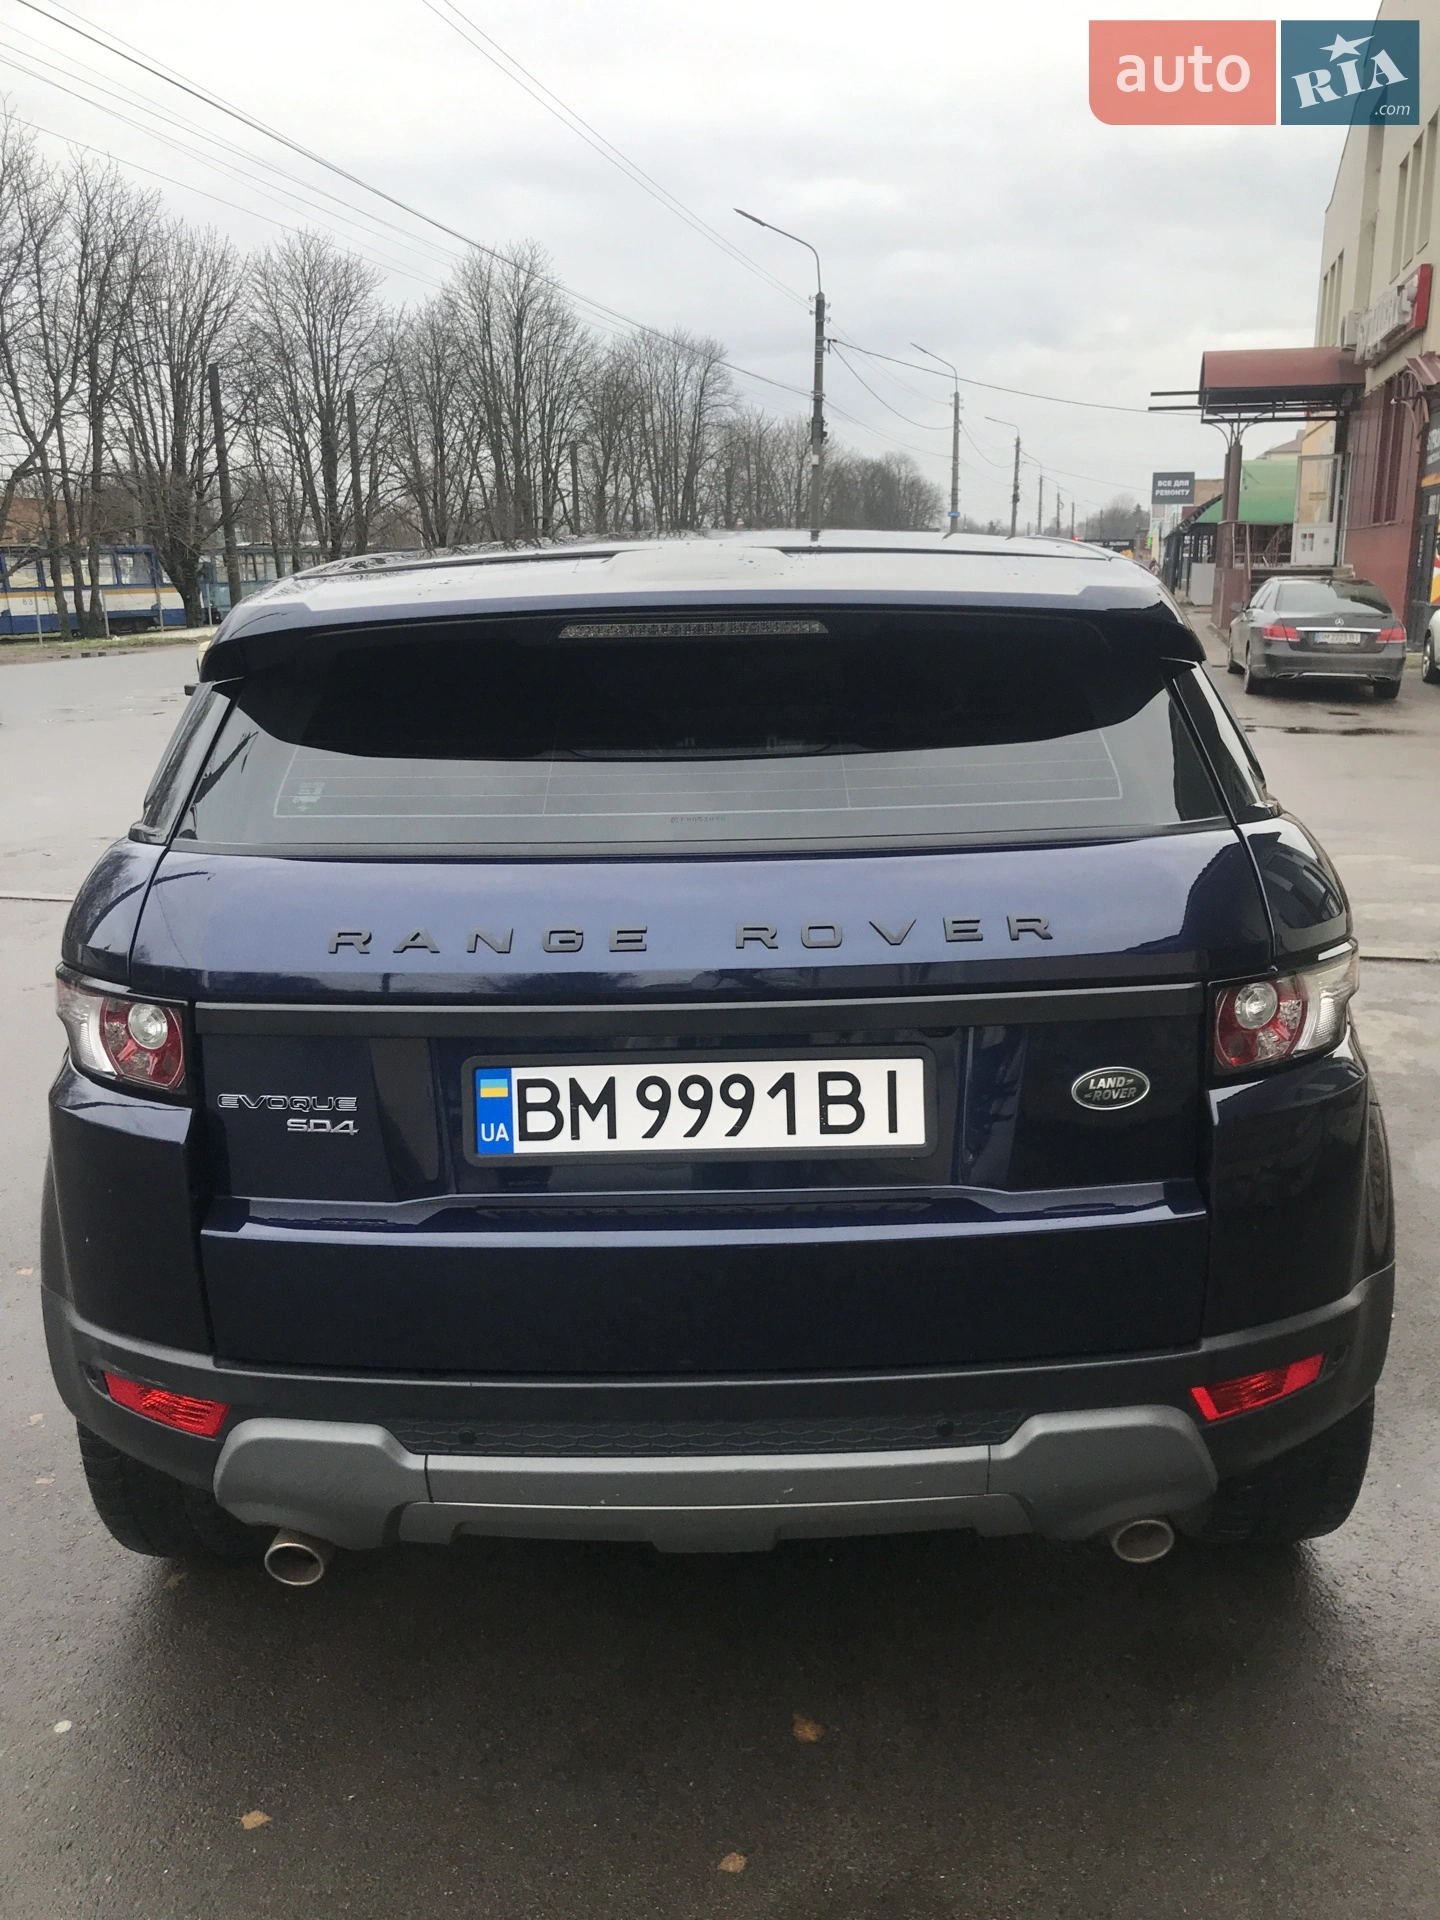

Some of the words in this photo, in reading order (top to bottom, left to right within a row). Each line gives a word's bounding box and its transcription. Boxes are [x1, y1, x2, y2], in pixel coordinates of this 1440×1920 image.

[1157, 479, 1173, 487] ВСЕ
[1173, 479, 1190, 488] ДЛЯ
[1154, 489, 1191, 497] РЕМОНТУ
[328, 927, 648, 954] RANGE
[735, 913, 1054, 951] ROVER
[1088, 1076, 1126, 1090] LAND
[217, 1093, 358, 1112] EVOQUE
[1092, 1086, 1137, 1101] ROVER
[516, 1075, 617, 1142] BM
[635, 1071, 797, 1140] 9991
[286, 1118, 360, 1136] SD4
[480, 1123, 510, 1143] UA
